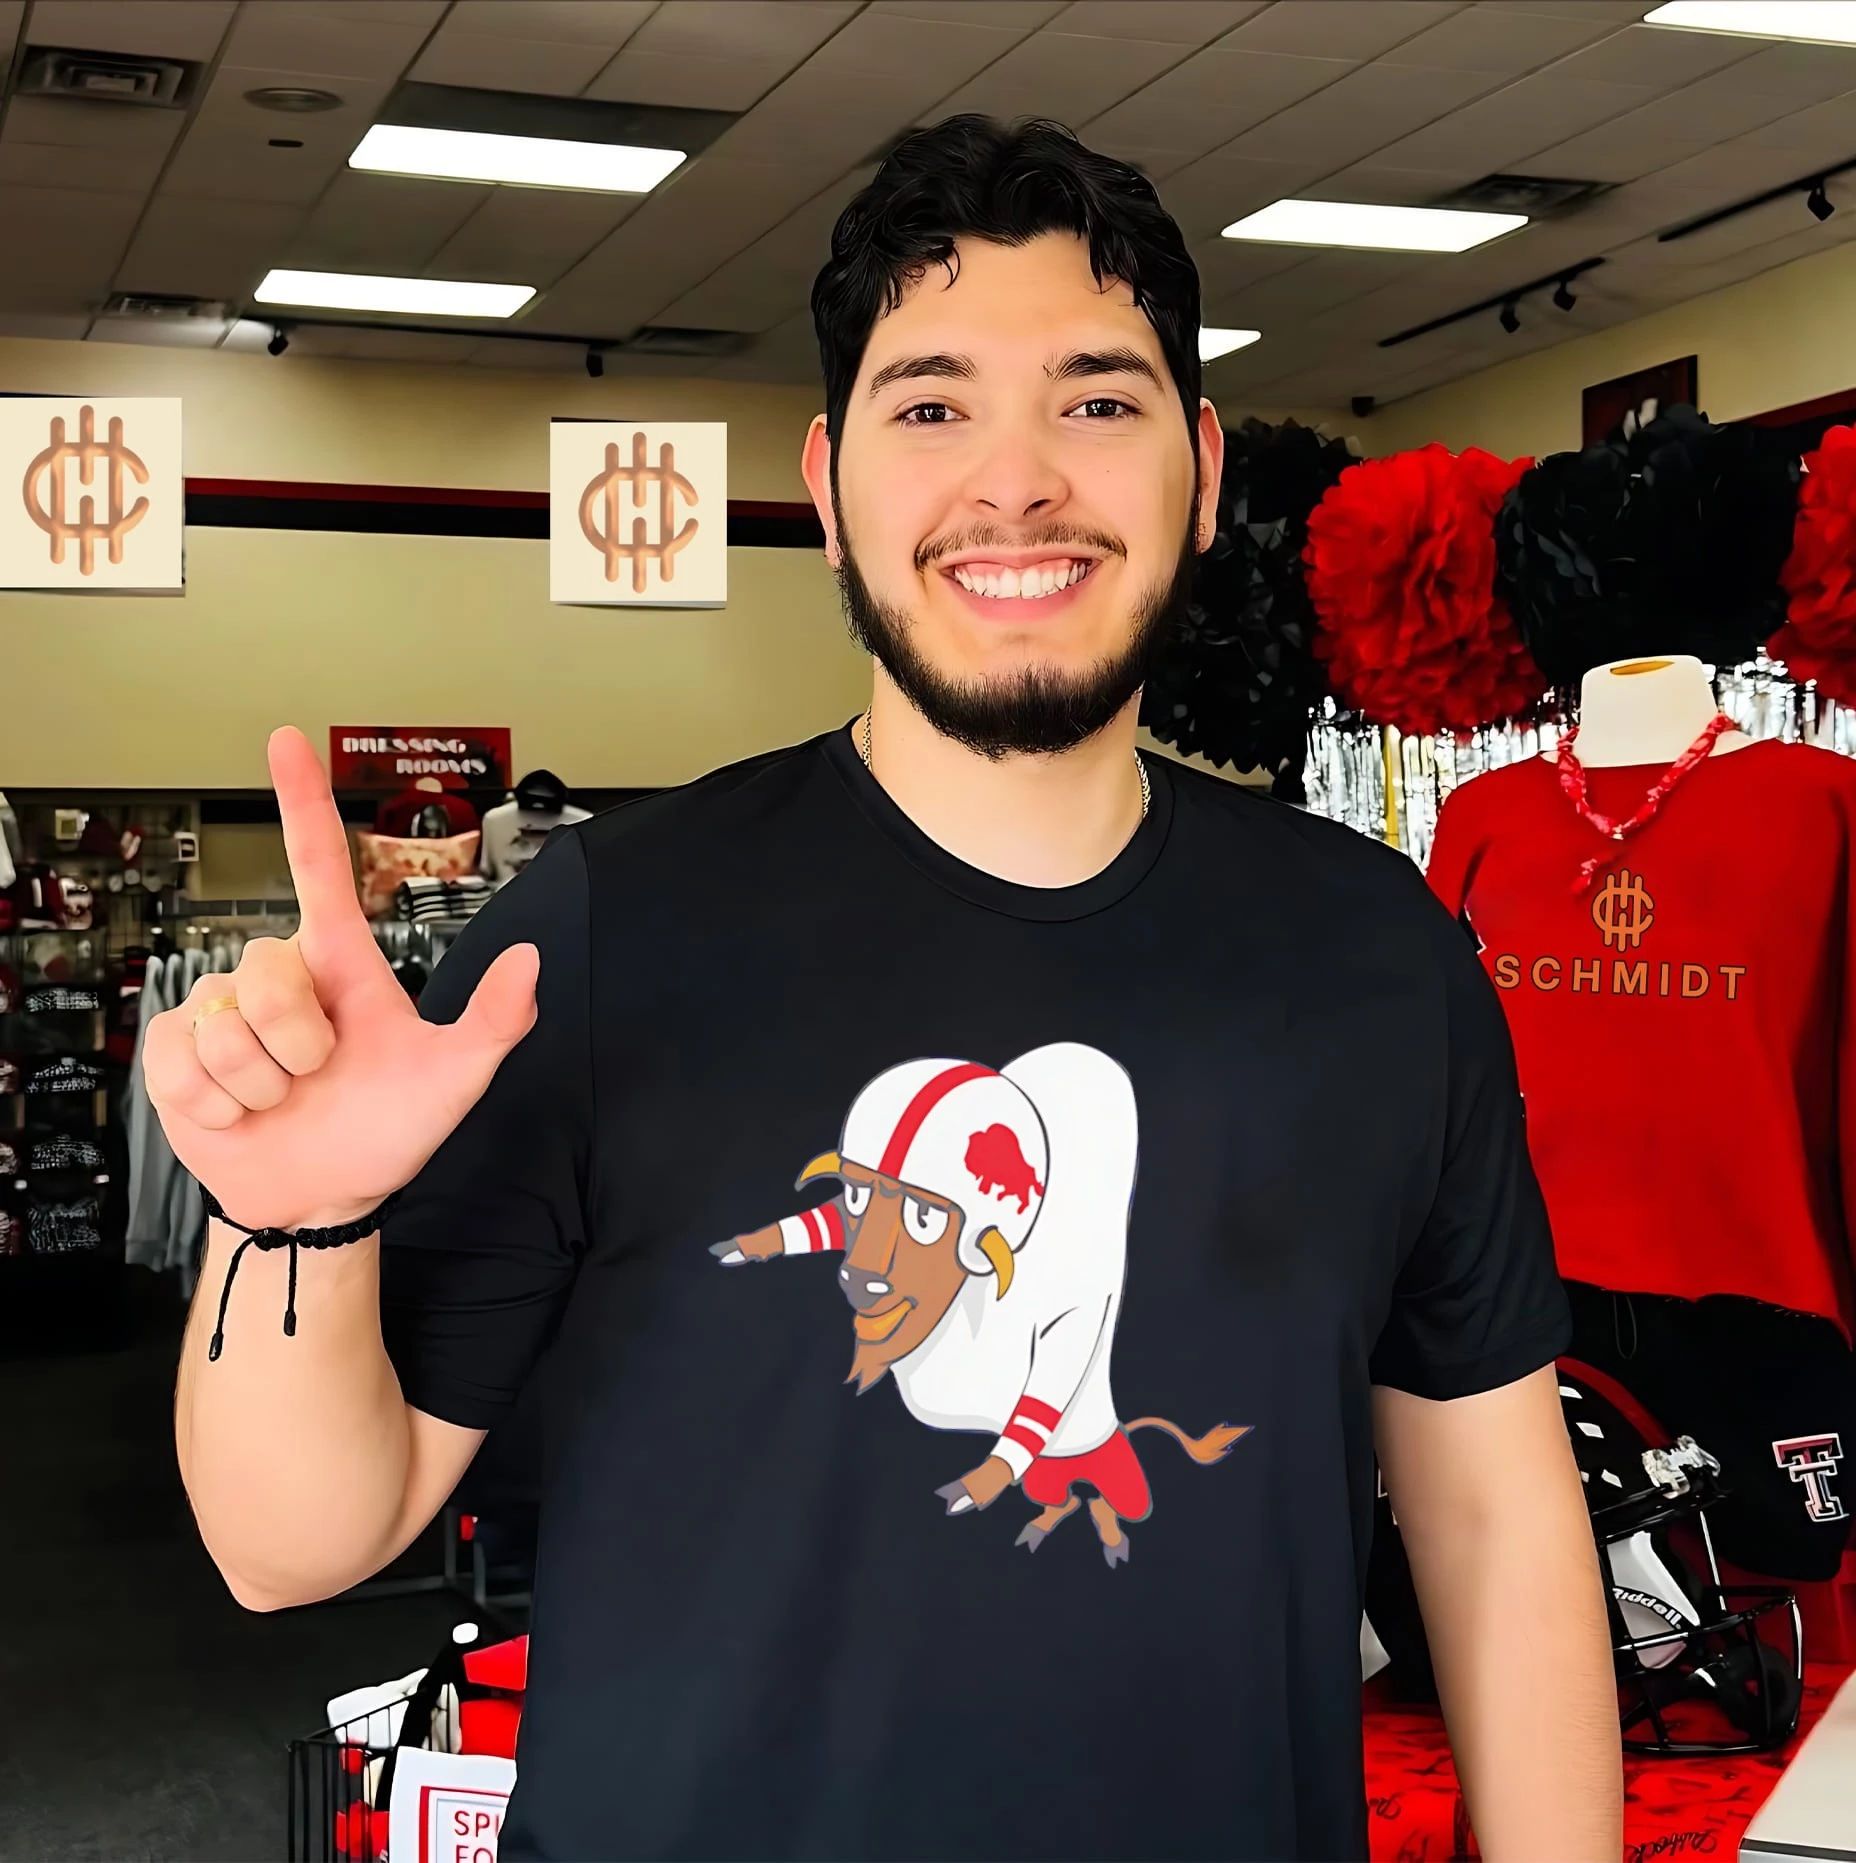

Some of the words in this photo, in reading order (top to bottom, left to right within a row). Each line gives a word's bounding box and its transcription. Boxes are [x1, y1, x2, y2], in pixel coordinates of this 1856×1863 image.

[342, 737, 466, 754] DRESSING
[396, 758, 486, 774] ROOMS
[1494, 954, 1747, 1000] SCHMIDT
